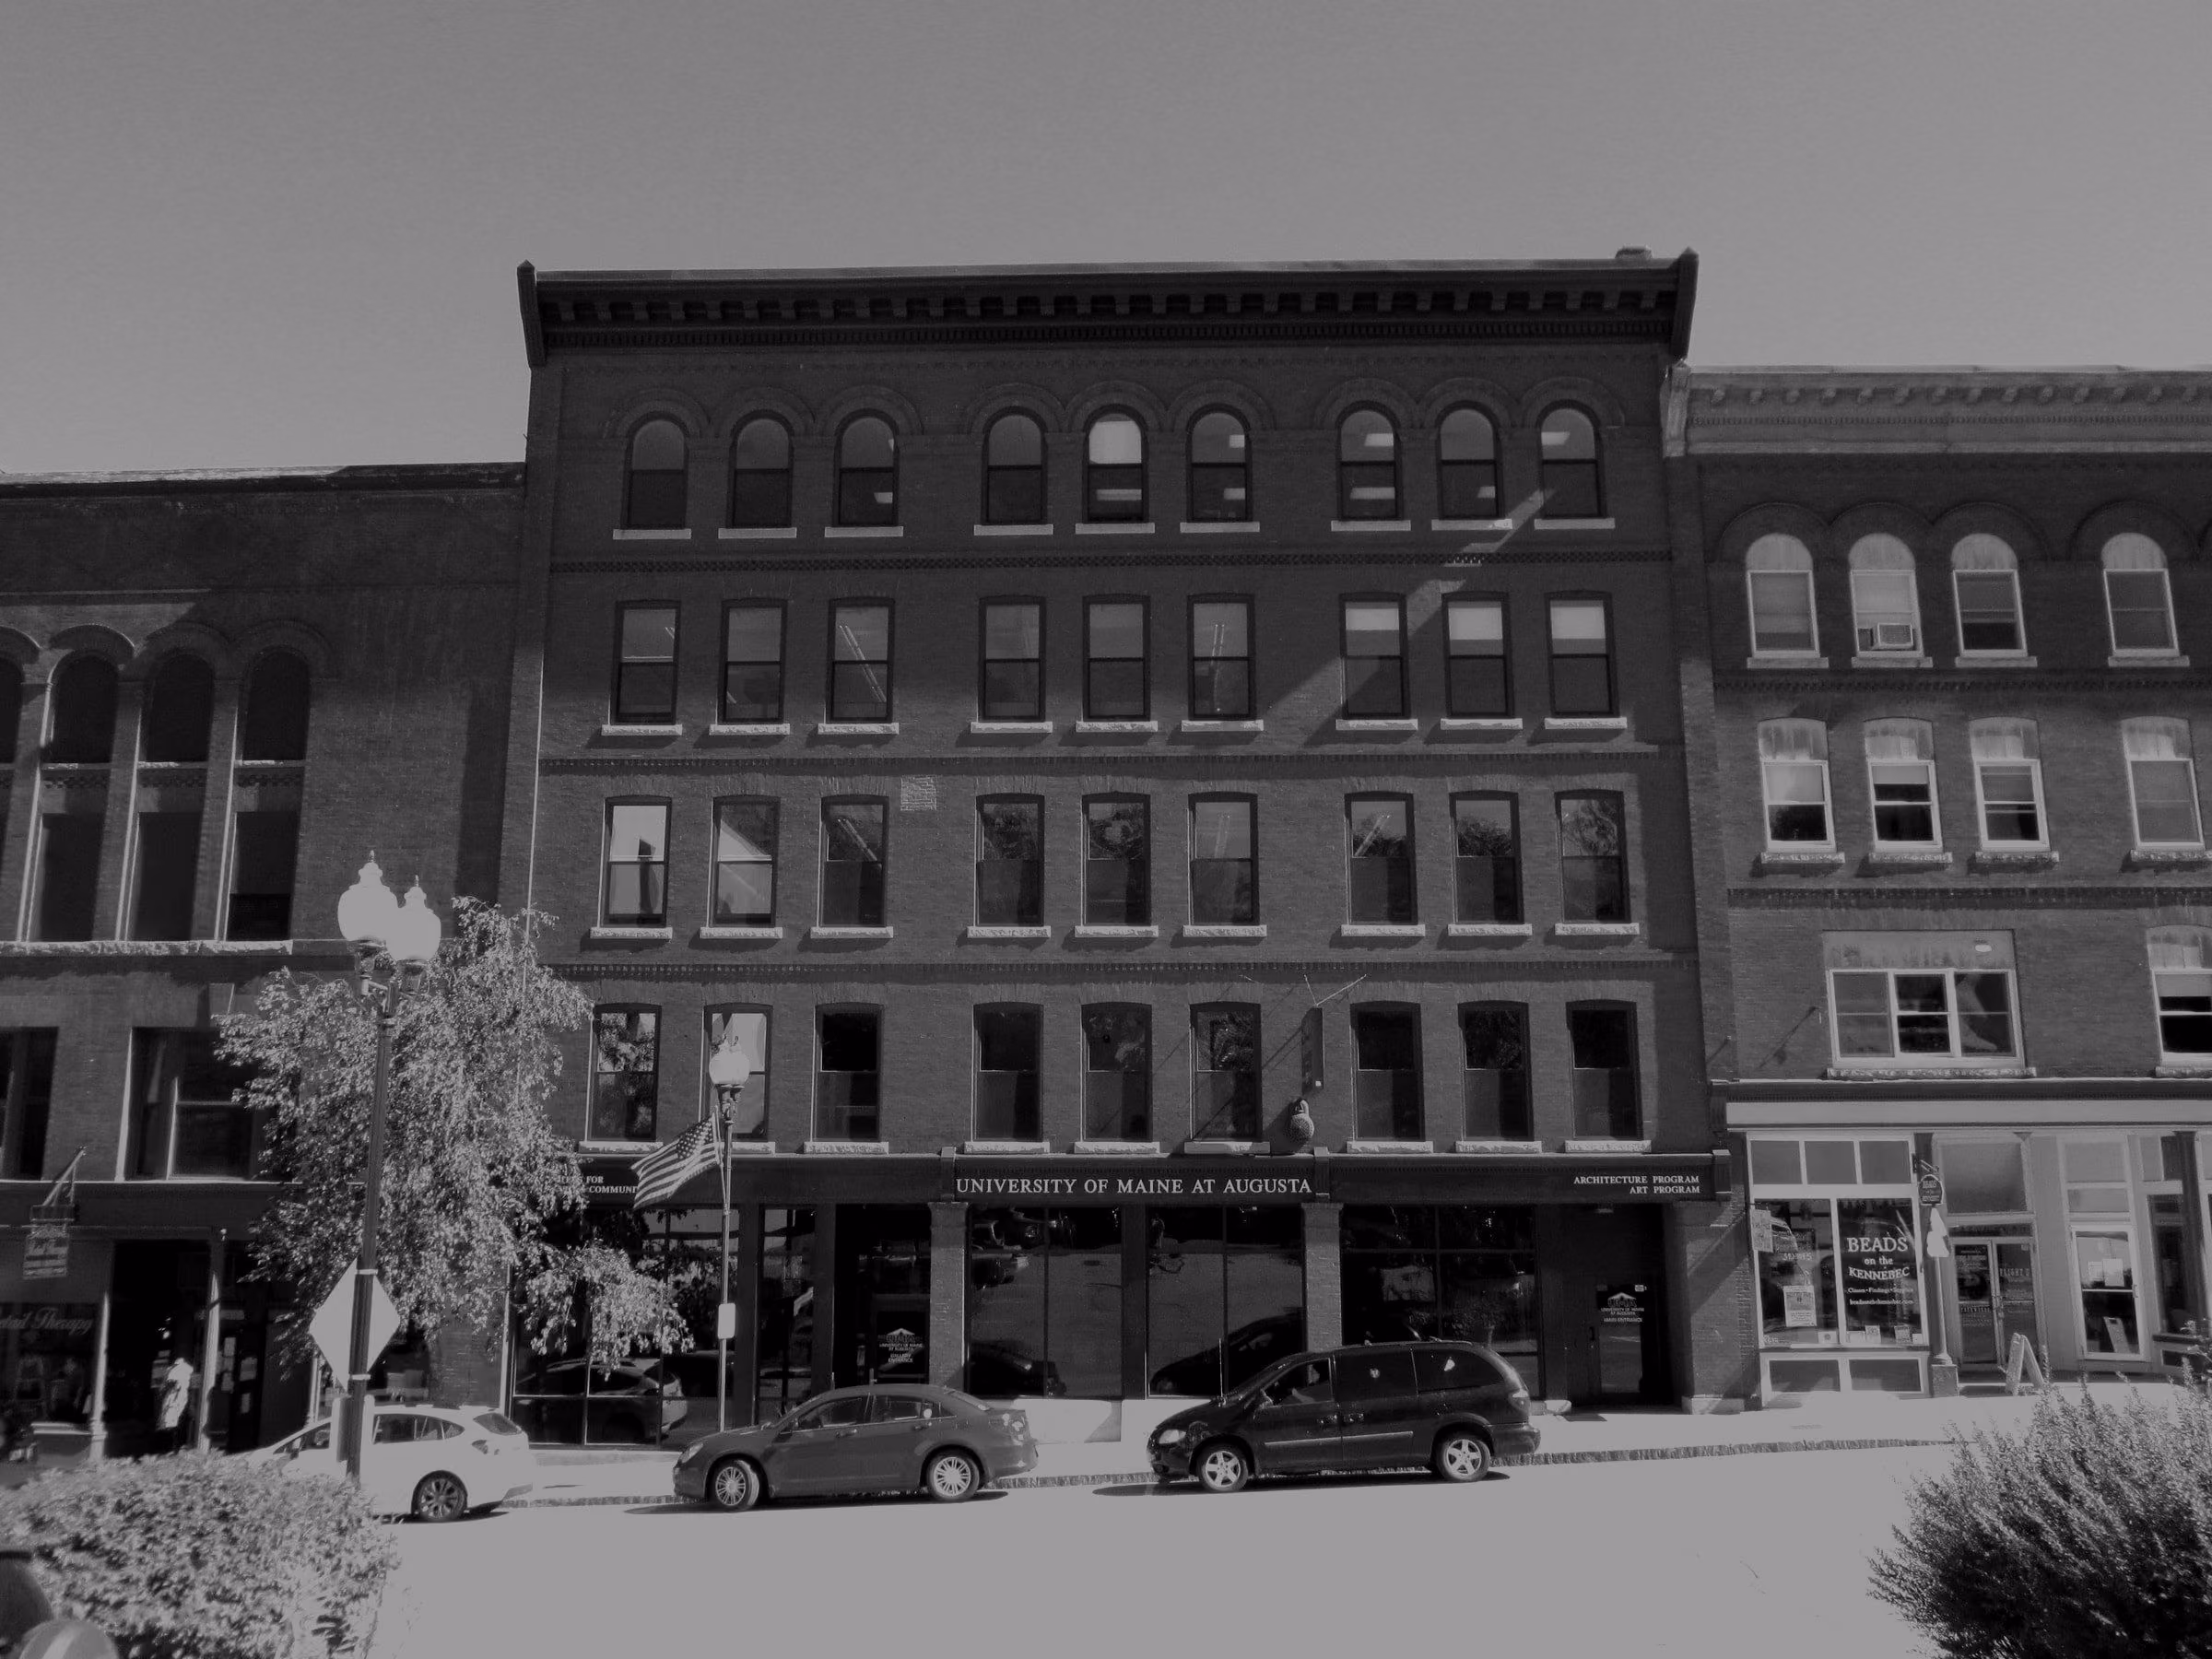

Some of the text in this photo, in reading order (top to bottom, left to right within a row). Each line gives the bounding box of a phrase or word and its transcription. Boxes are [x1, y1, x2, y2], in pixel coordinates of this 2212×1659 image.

[586, 1175, 604, 1183] FOR
[1573, 1175, 1700, 1184] ARCHITECTURE PROGRAM
[956, 1177, 1312, 1194] UNIVERSITY OF MAINE AT AUGUSTA
[1630, 1185, 1700, 1194] ART PROGRAM
[1846, 1237, 1909, 1253] BEADS
[1878, 1255, 1894, 1265] the
[1848, 1266, 1911, 1281] KENNEBEC
